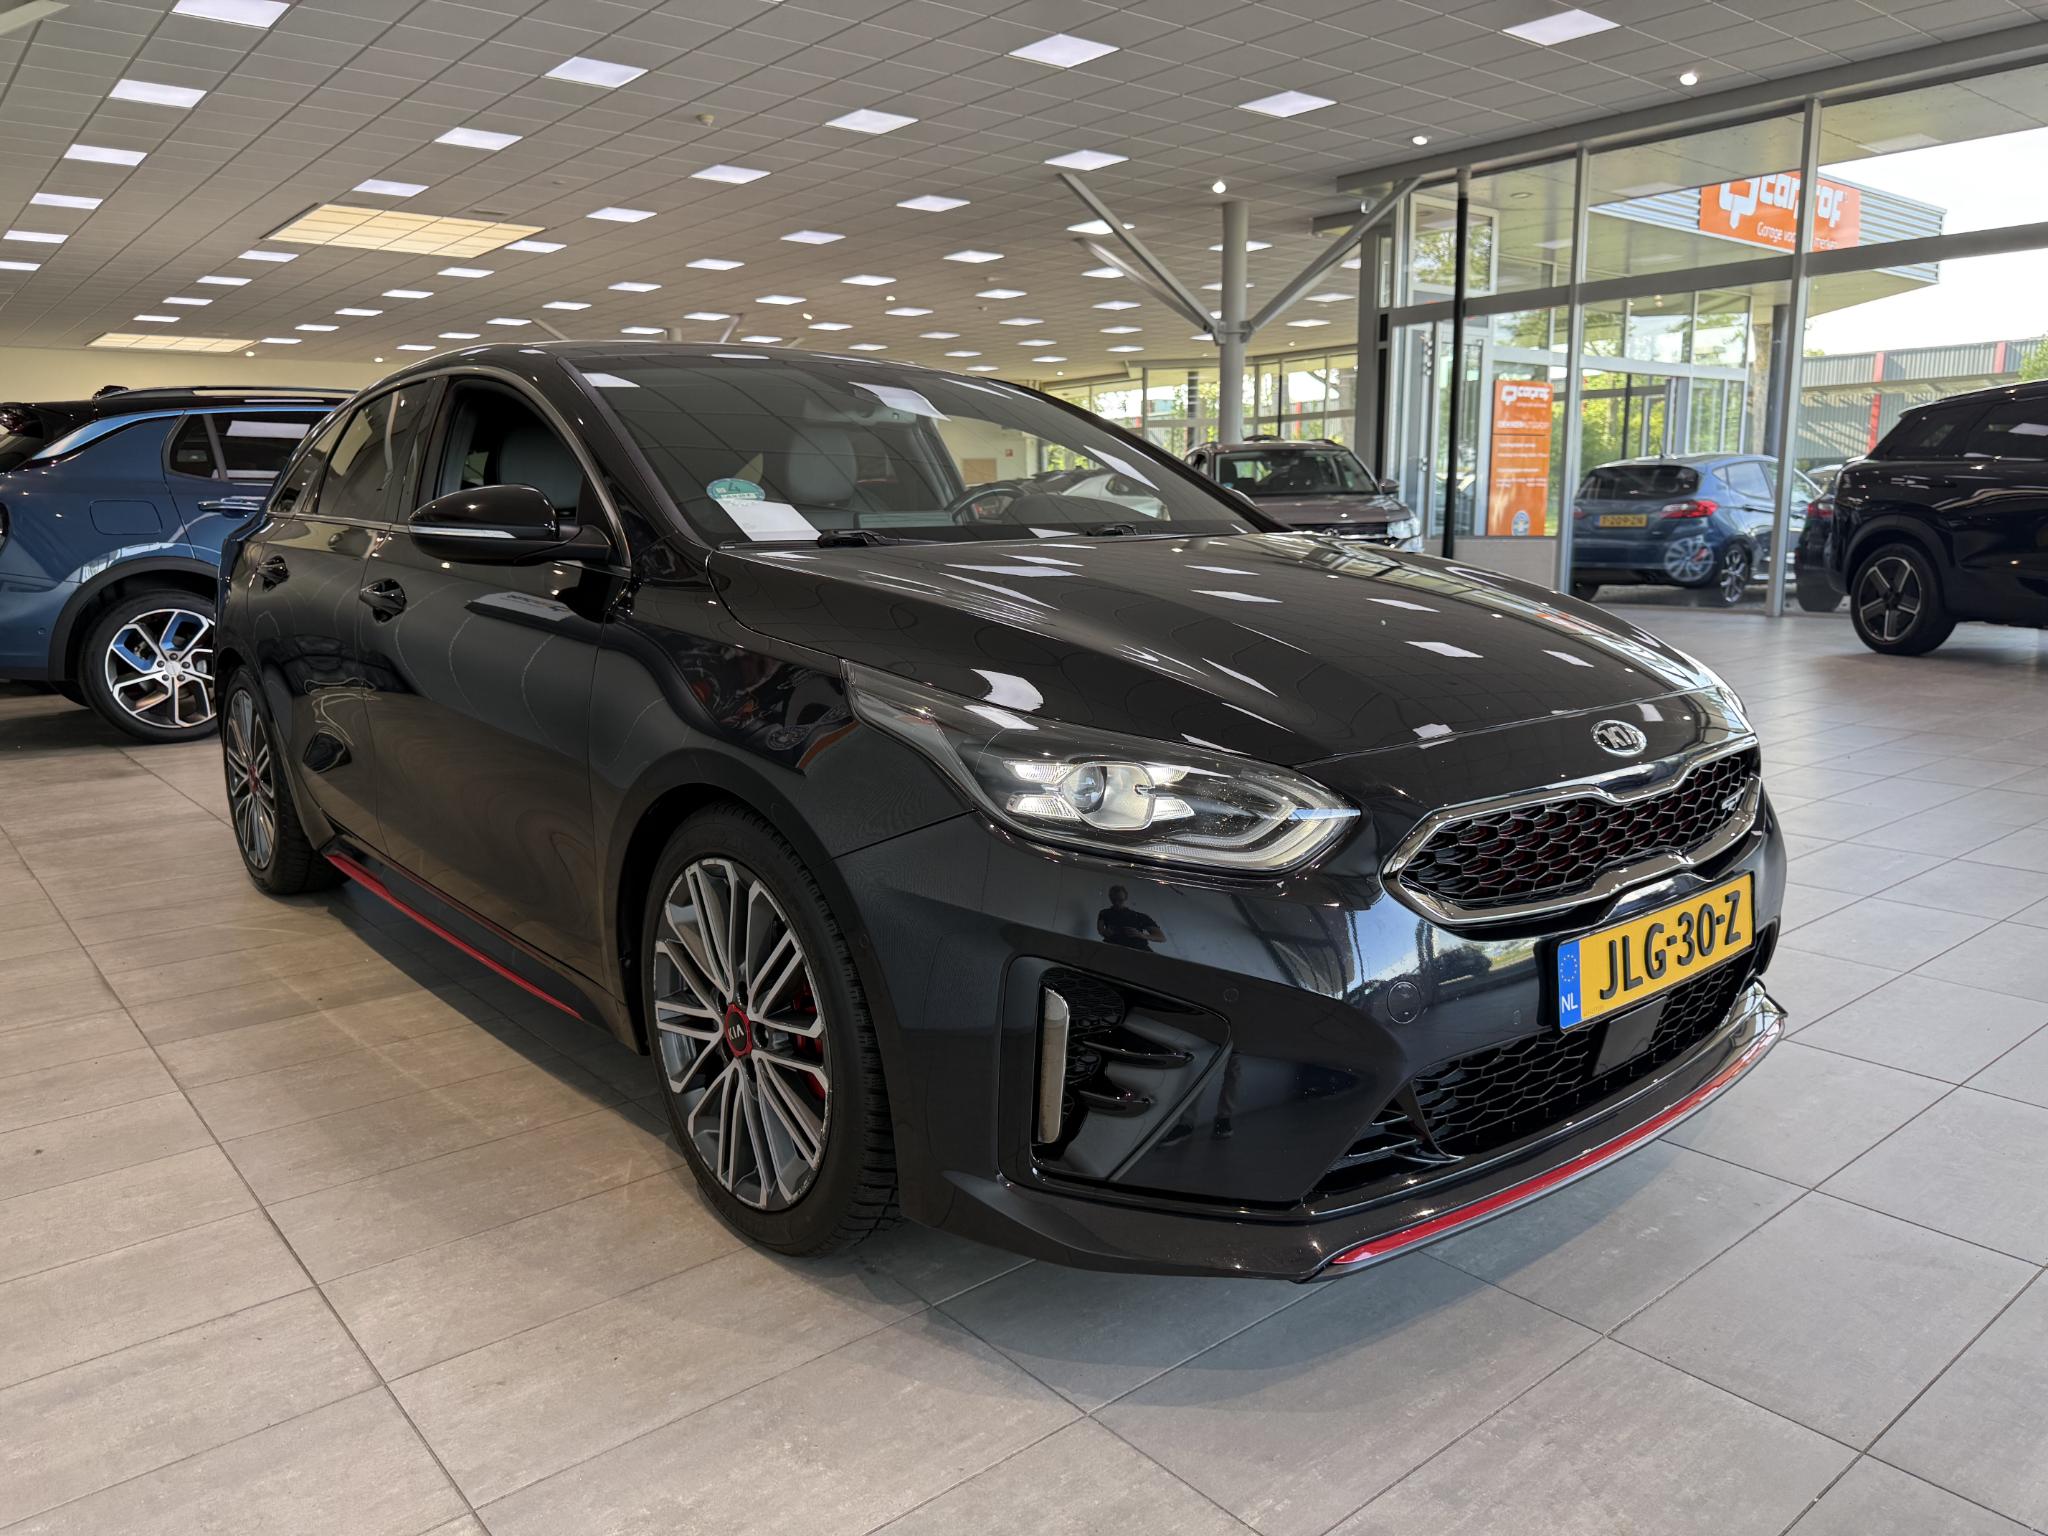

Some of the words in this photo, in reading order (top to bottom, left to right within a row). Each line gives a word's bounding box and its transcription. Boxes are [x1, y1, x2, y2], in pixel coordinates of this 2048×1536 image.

[1760, 174, 1843, 228] carof
[1757, 221, 1783, 243] Garage
[1597, 725, 1640, 749] KIA
[1600, 890, 1741, 1000] JLG-30-Z
[1561, 992, 1578, 1013] NL
[728, 1023, 744, 1040] KIA
